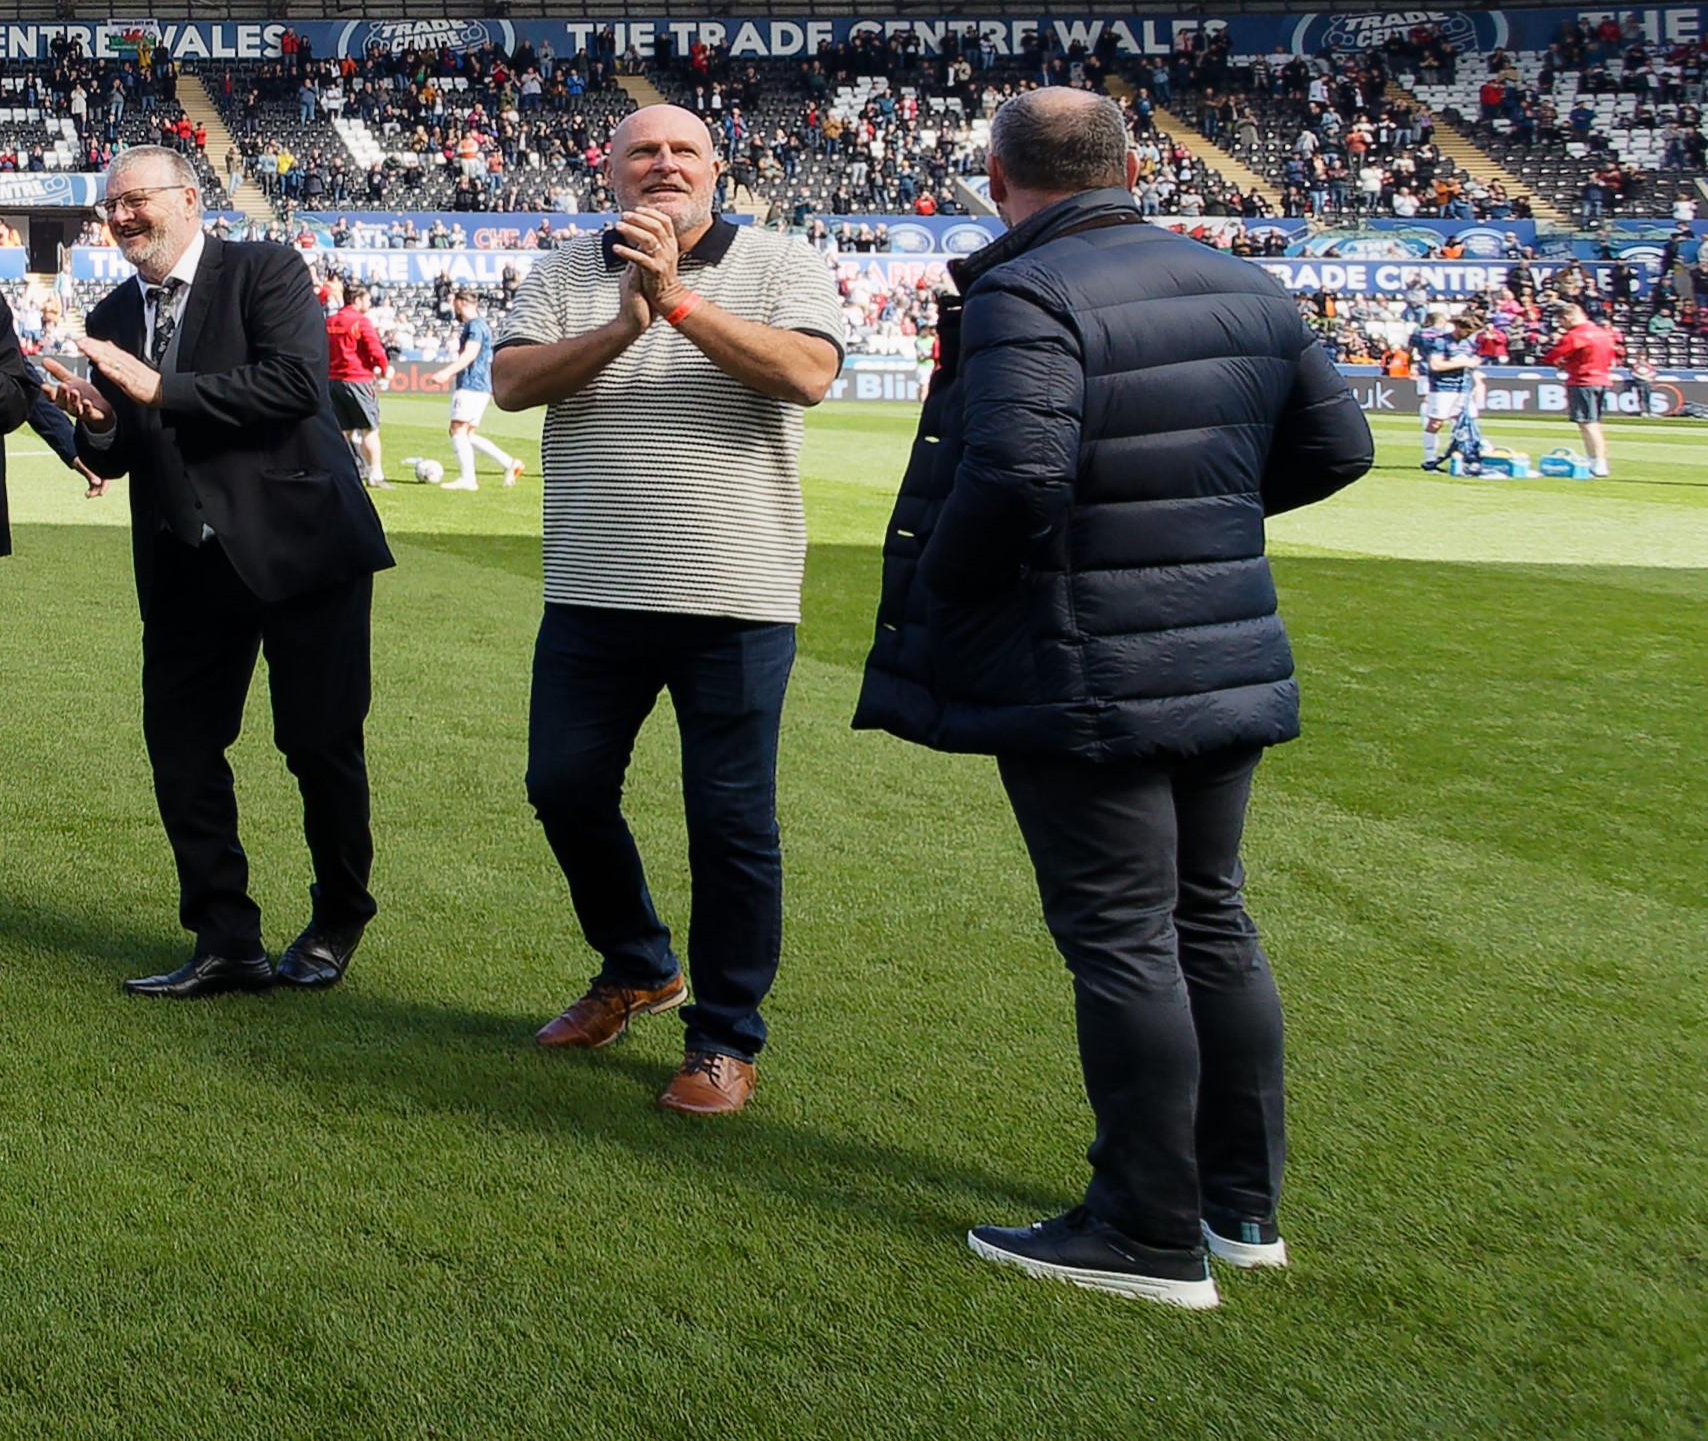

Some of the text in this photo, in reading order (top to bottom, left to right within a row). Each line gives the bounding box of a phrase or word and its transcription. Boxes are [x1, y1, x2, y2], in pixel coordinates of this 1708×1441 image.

[382, 19, 469, 36] TRADE
[1344, 11, 1451, 31] TRADE
[1375, 265, 1508, 292] CENTRE
